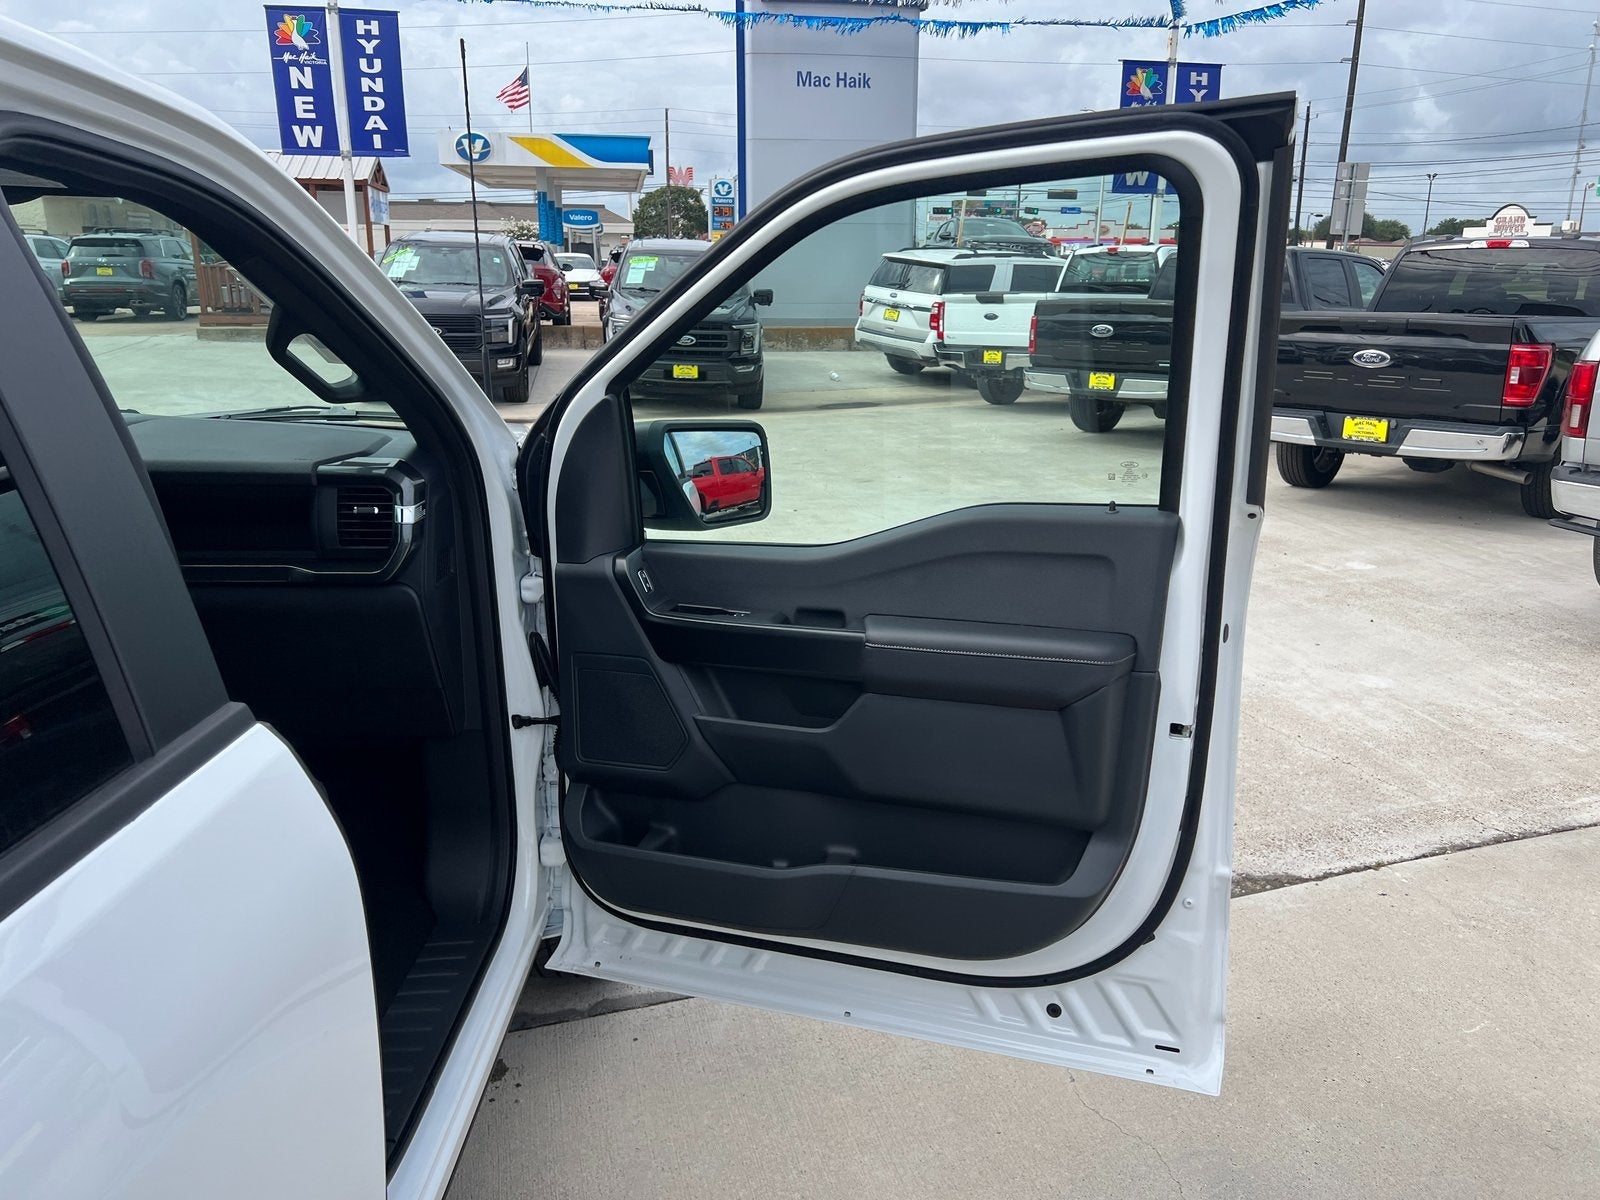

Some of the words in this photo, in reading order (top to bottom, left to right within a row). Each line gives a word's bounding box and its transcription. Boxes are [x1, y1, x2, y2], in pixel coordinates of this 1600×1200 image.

[355, 19, 389, 149] HYUNDAI
[796, 70, 831, 88] Mac
[836, 71, 872, 89] Haik
[288, 65, 324, 148] NEW
[568, 213, 593, 221] Valero
[1360, 352, 1382, 364] Ford
